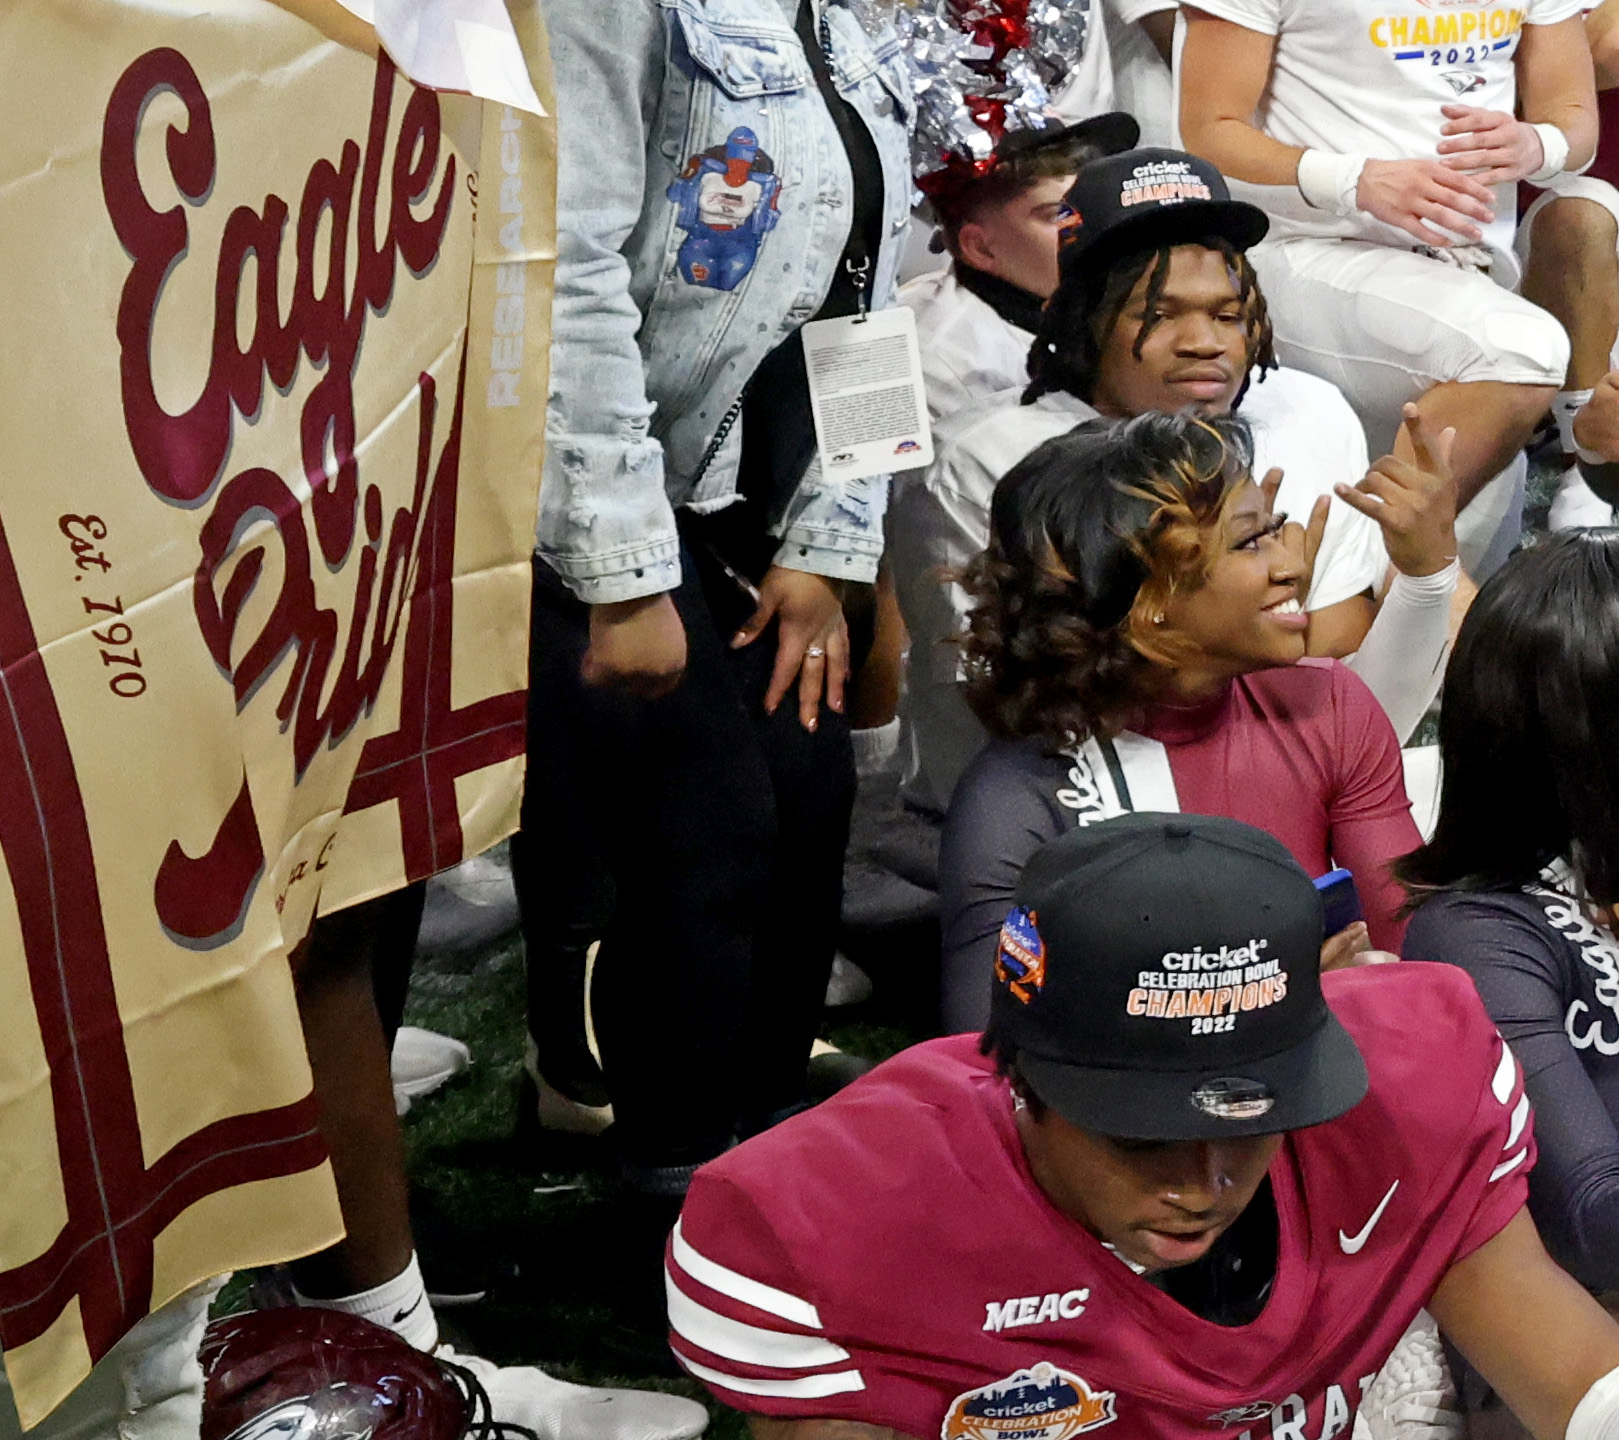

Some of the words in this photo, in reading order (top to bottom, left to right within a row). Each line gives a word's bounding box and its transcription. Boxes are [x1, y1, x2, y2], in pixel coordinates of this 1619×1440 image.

[1430, 45, 1490, 68] 2022
[1132, 159, 1190, 180] cricket
[1120, 183, 1211, 209] CHAMPIONS
[101, 46, 457, 569] Eagle
[59, 513, 110, 583] Est.
[79, 594, 149, 699] 1970
[1162, 938, 1260, 970] cricket
[1138, 966, 1239, 991] CELEBRATION
[1243, 957, 1282, 982] BOWL
[1126, 970, 1288, 1021] CHAMPIONS
[1191, 1013, 1237, 1036] 2022
[983, 1287, 1090, 1334] MEAC
[960, 1403, 1084, 1435] CELEBRATION
[985, 1393, 1057, 1418] cricket
